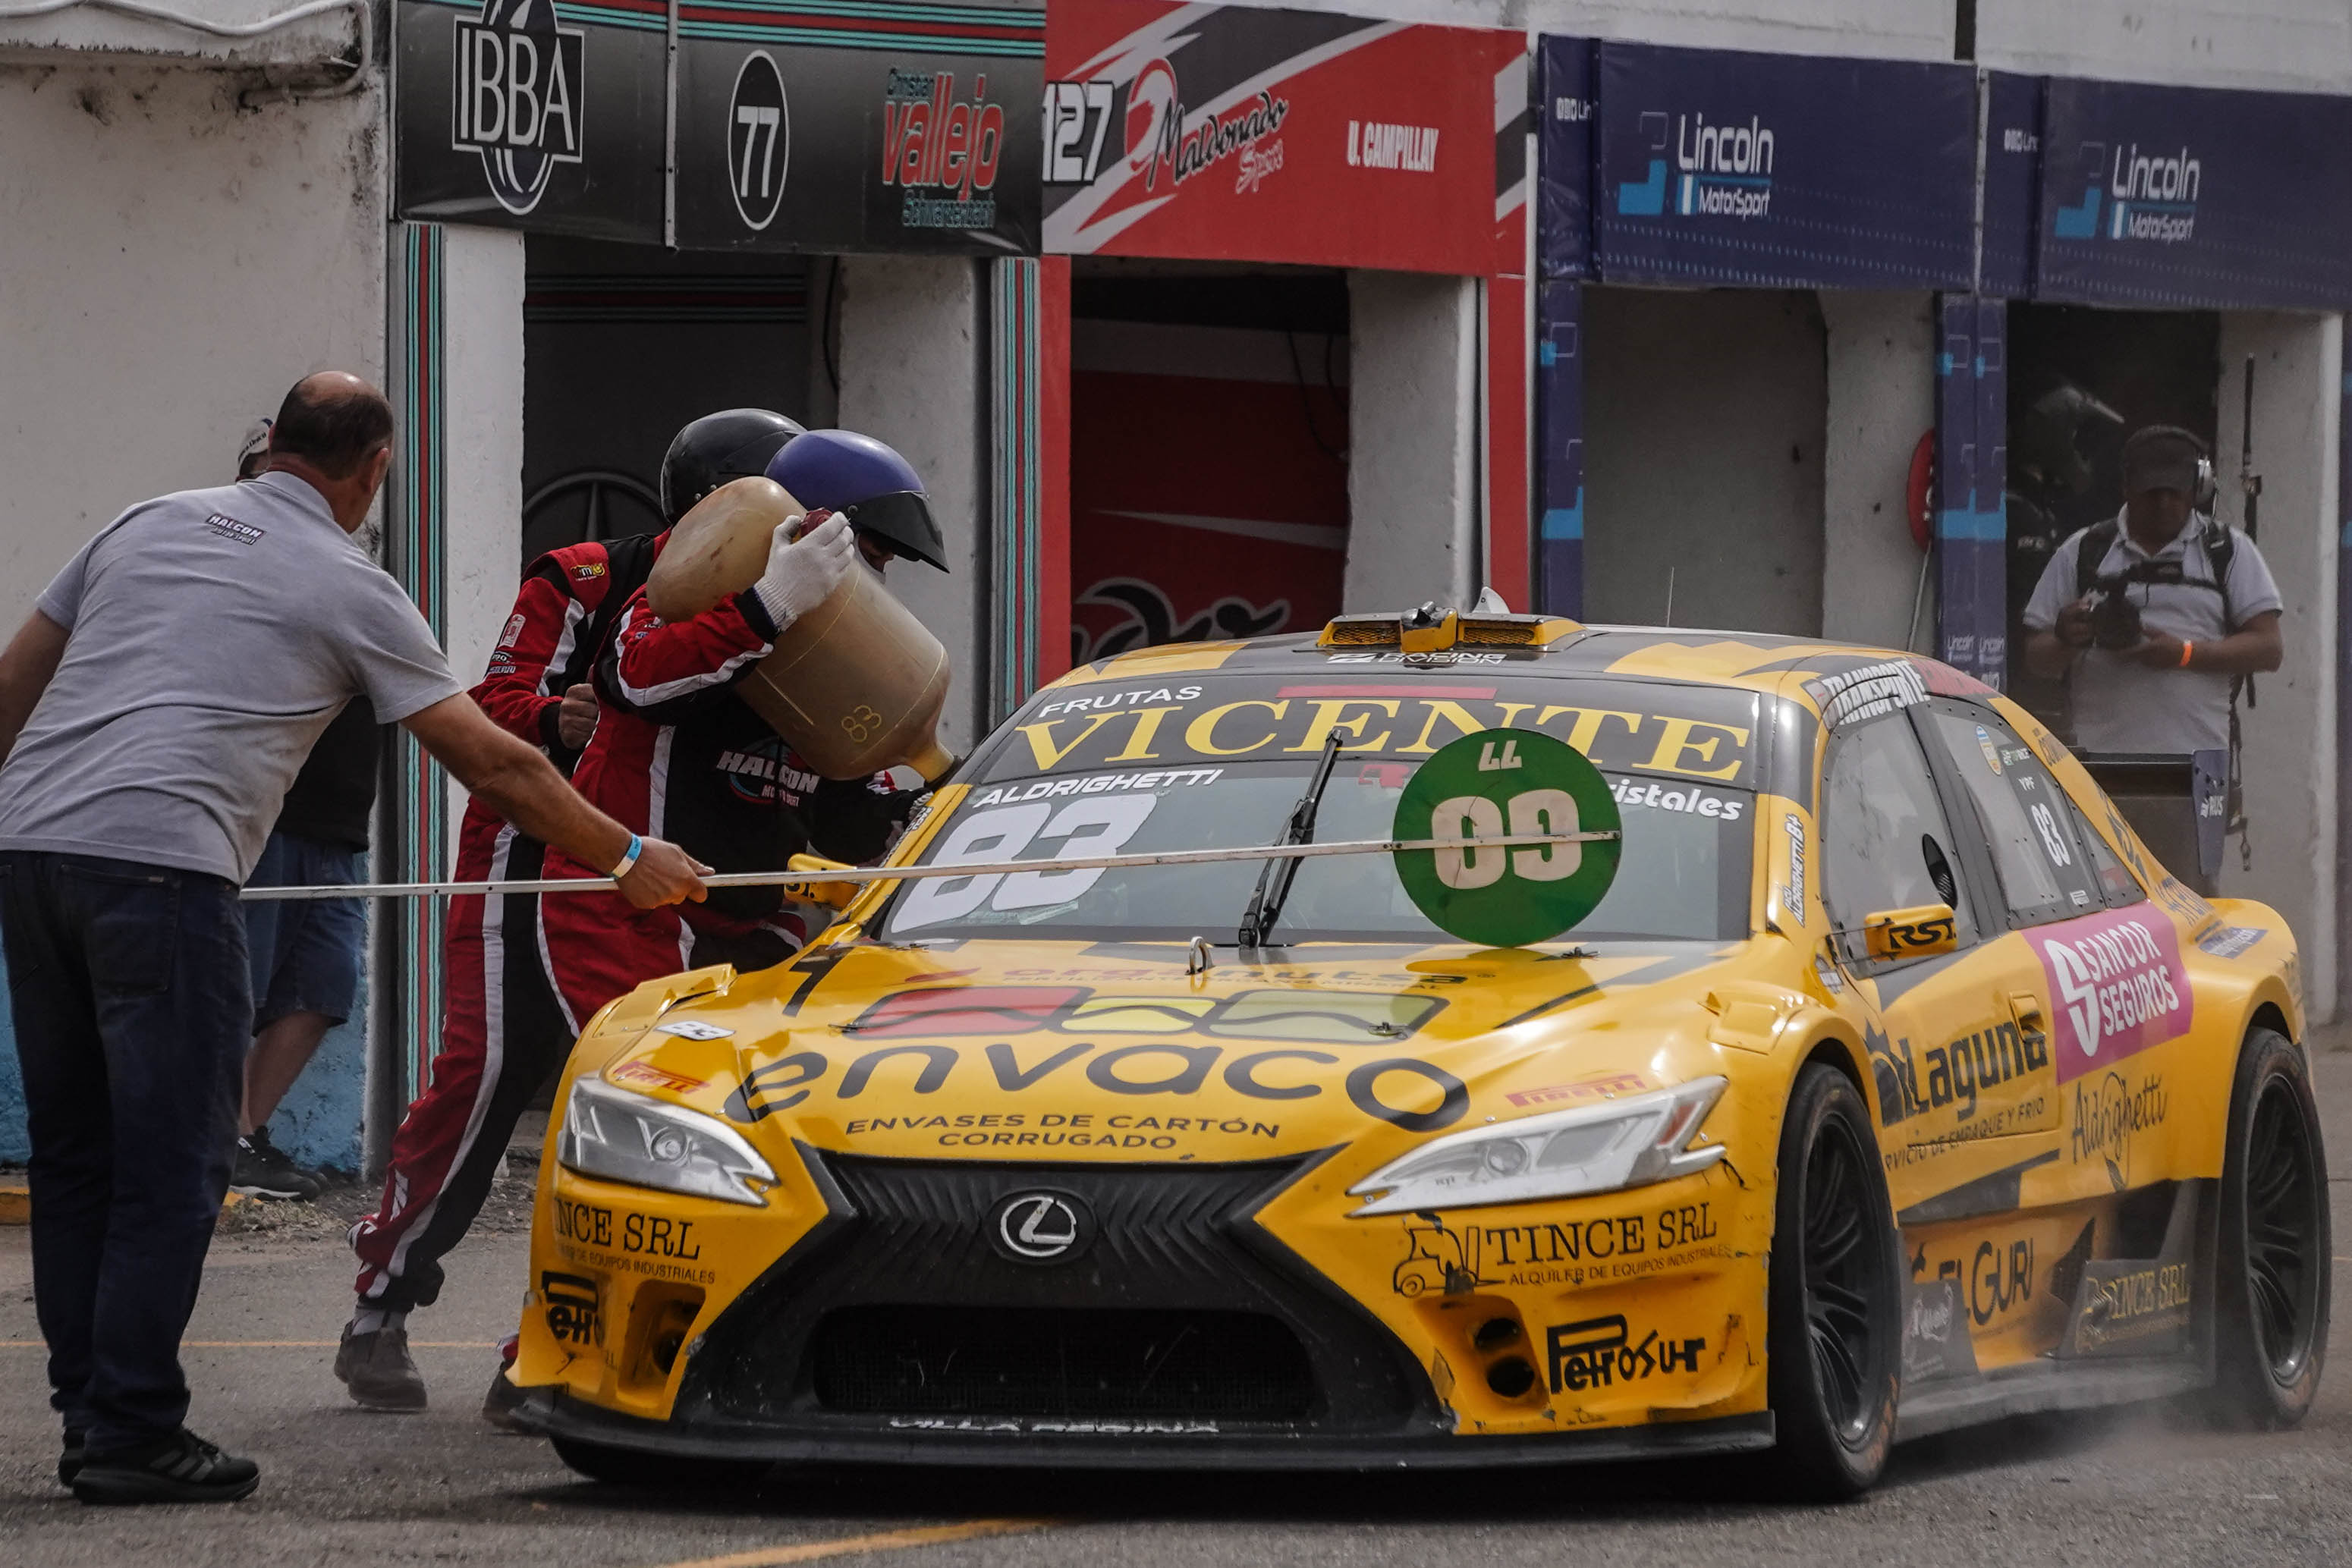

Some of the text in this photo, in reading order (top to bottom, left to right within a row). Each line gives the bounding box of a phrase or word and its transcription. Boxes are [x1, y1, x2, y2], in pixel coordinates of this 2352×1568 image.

[461, 27, 575, 151] IBBA
[737, 105, 781, 198] 77
[1042, 81, 1115, 184] 127
[1363, 121, 1439, 172] CAMPILLAY
[1678, 112, 1775, 174] Lincoln
[2112, 142, 2201, 201] Lincoln
[208, 515, 264, 539] HALCON
[841, 705, 882, 743] 83
[1037, 685, 1203, 719] FRUTAS
[1015, 698, 1750, 782] VICENTE
[716, 750, 820, 794] HALCON
[973, 768, 1224, 808] ALDRIGHETTI
[891, 794, 1158, 933] 83
[2030, 803, 2071, 867] 83
[2074, 921, 2162, 982] SANCOR
[2099, 965, 2180, 1037] SEGUROS
[724, 1042, 1472, 1133] envaco
[1898, 1020, 2049, 1123] Laguna
[845, 1114, 1281, 1139] ENVASES DE CARTÓN
[938, 1132, 1178, 1150] CORRUGADO
[2007, 1108, 2016, 1126] Y
[554, 1197, 701, 1261] NCE SRL
[1487, 1202, 1718, 1266] TINCE SRL
[634, 1259, 715, 1285] INDUSTRIALES
[1589, 1264, 1608, 1280] DE
[1613, 1256, 1665, 1277] EQUIPOS
[1973, 1237, 2035, 1327] GURI
